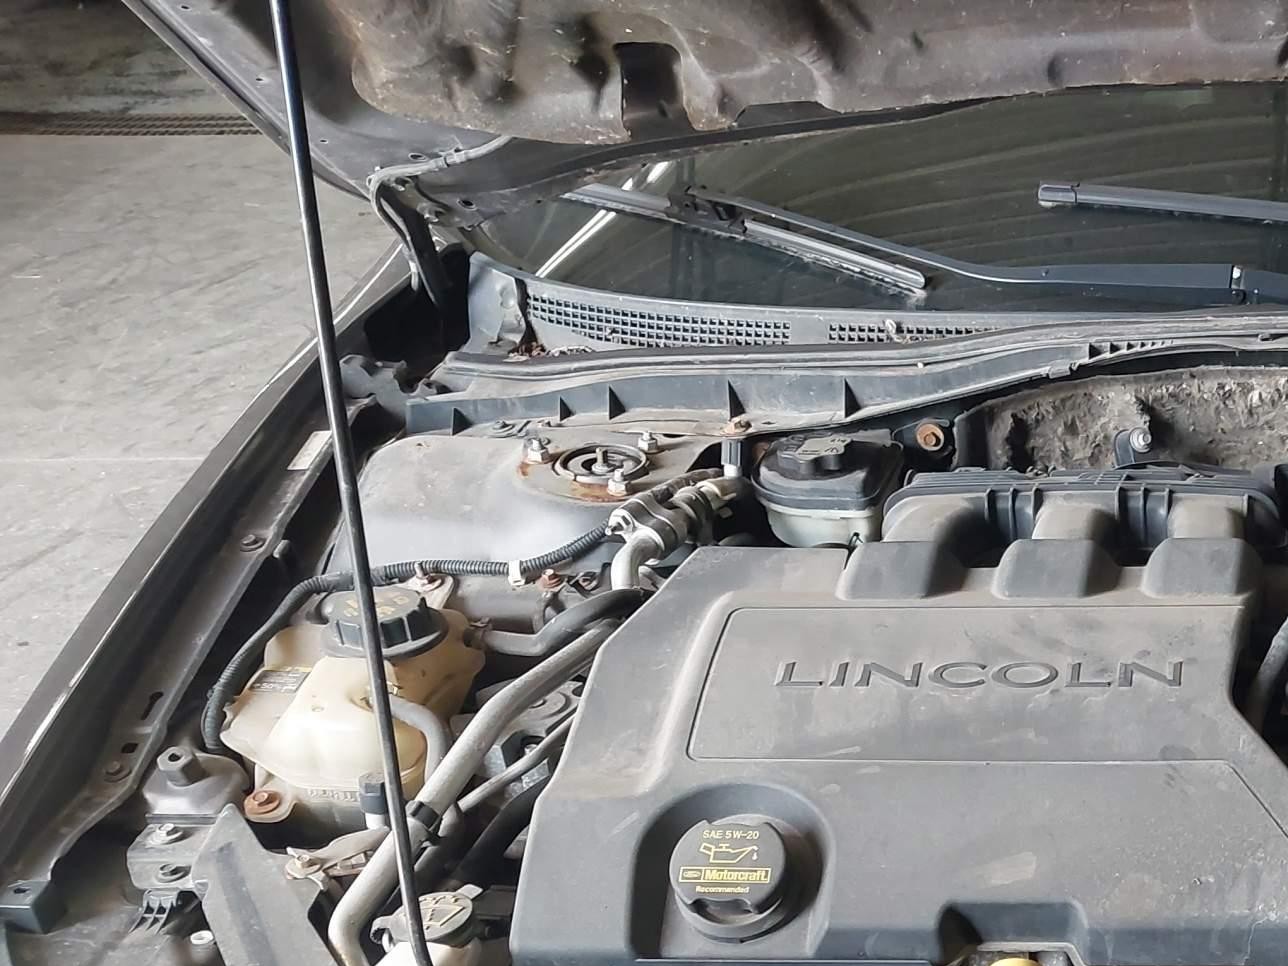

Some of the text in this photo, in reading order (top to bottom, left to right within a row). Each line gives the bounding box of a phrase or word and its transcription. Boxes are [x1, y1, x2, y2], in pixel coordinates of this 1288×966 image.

[774, 661, 1184, 688] LINCOLN
[702, 829, 760, 840] SAE 5W-20
[695, 885, 751, 894] Recommended
